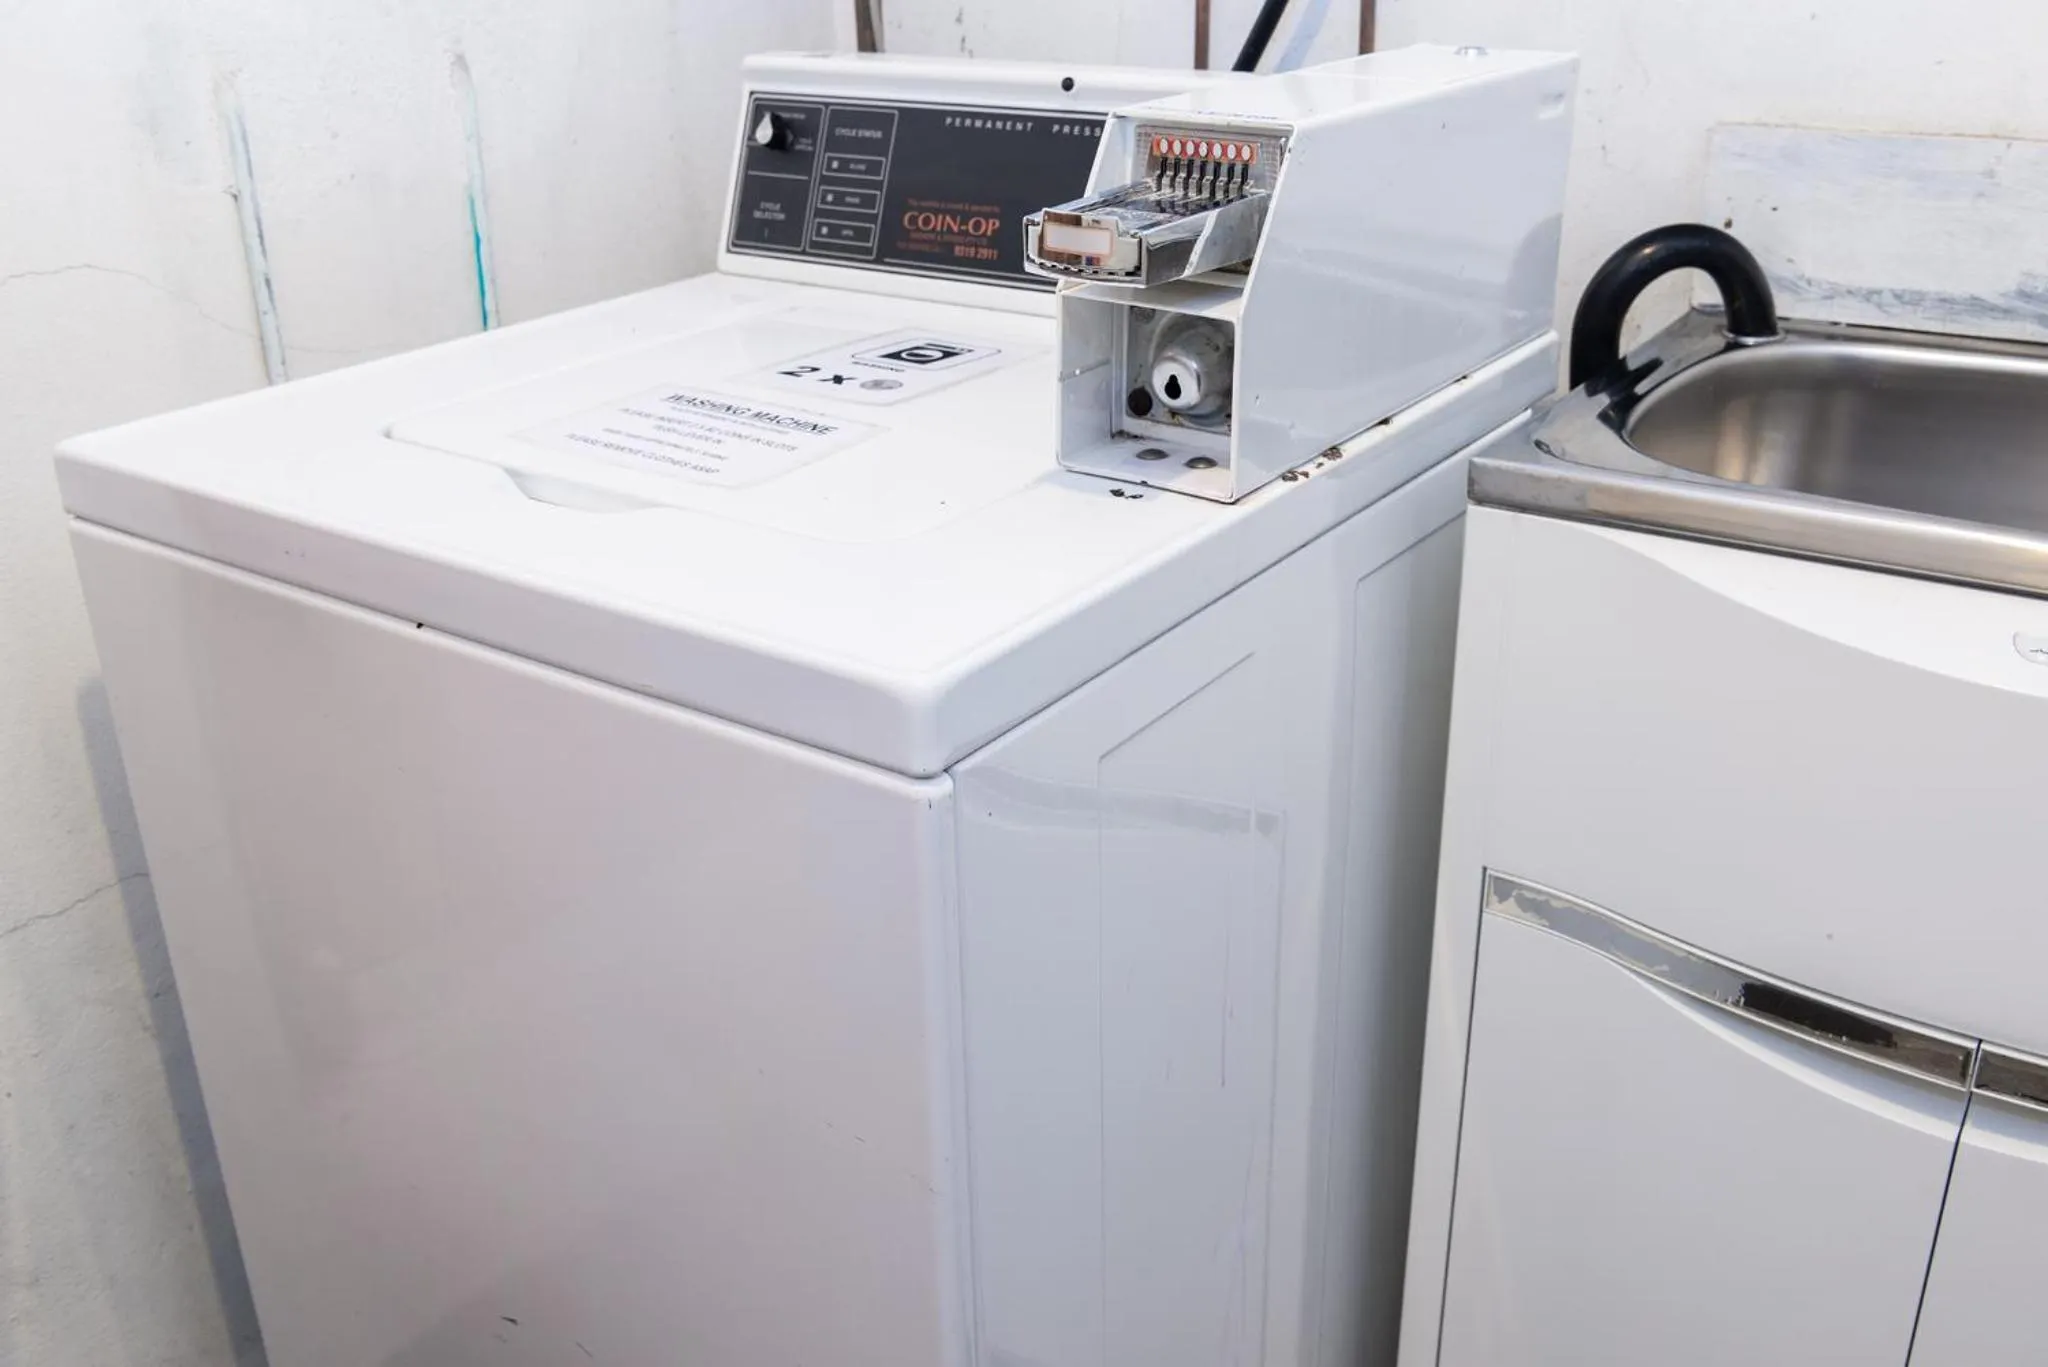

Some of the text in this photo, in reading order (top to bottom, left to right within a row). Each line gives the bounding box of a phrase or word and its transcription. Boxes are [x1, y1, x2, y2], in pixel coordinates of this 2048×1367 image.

[944, 116, 1035, 132] PERMANENT
[834, 126, 883, 139] CYCLE STATUS
[760, 201, 782, 212] CYCLE
[752, 210, 786, 221] SELECTOR
[903, 211, 1001, 237] COIN-OP
[776, 365, 822, 378] 2
[661, 392, 753, 416] WASHING
[748, 410, 840, 436] MACHINE
